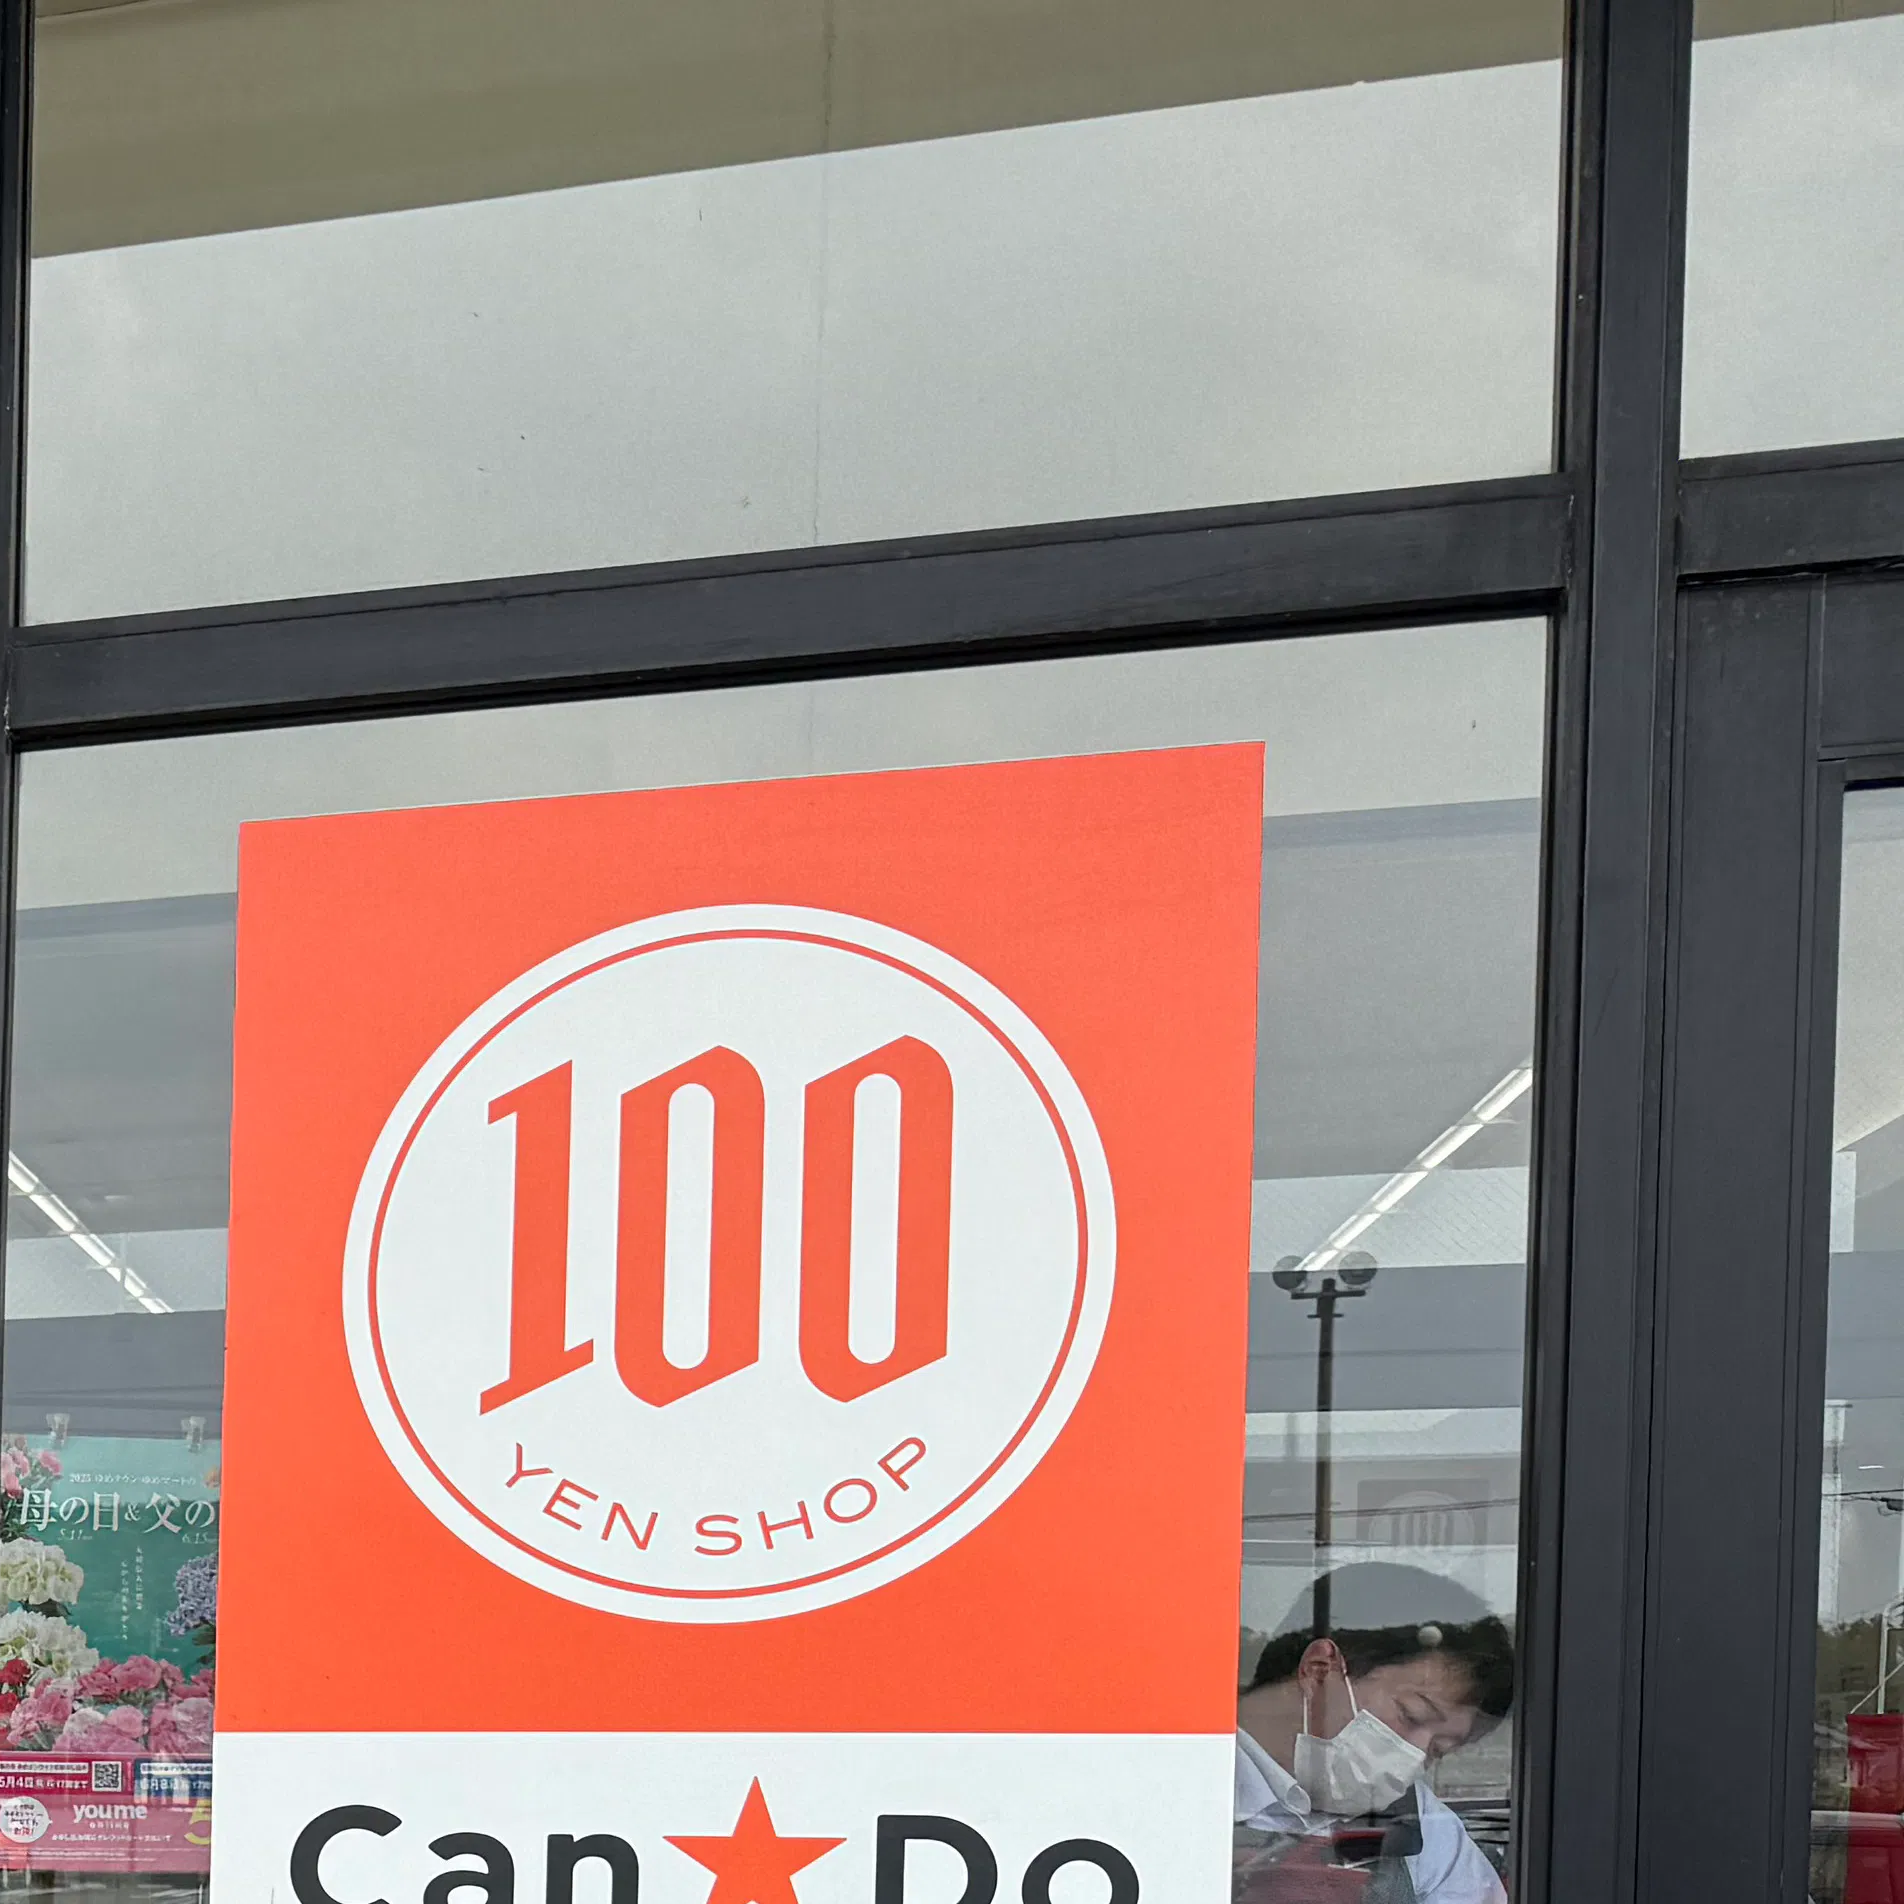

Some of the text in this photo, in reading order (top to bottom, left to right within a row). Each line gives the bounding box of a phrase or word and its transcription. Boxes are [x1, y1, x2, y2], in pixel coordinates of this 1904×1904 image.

[479, 1034, 954, 1416] 100
[503, 1434, 928, 1556] YEN SHOP
[73, 1803, 148, 1823] youme
